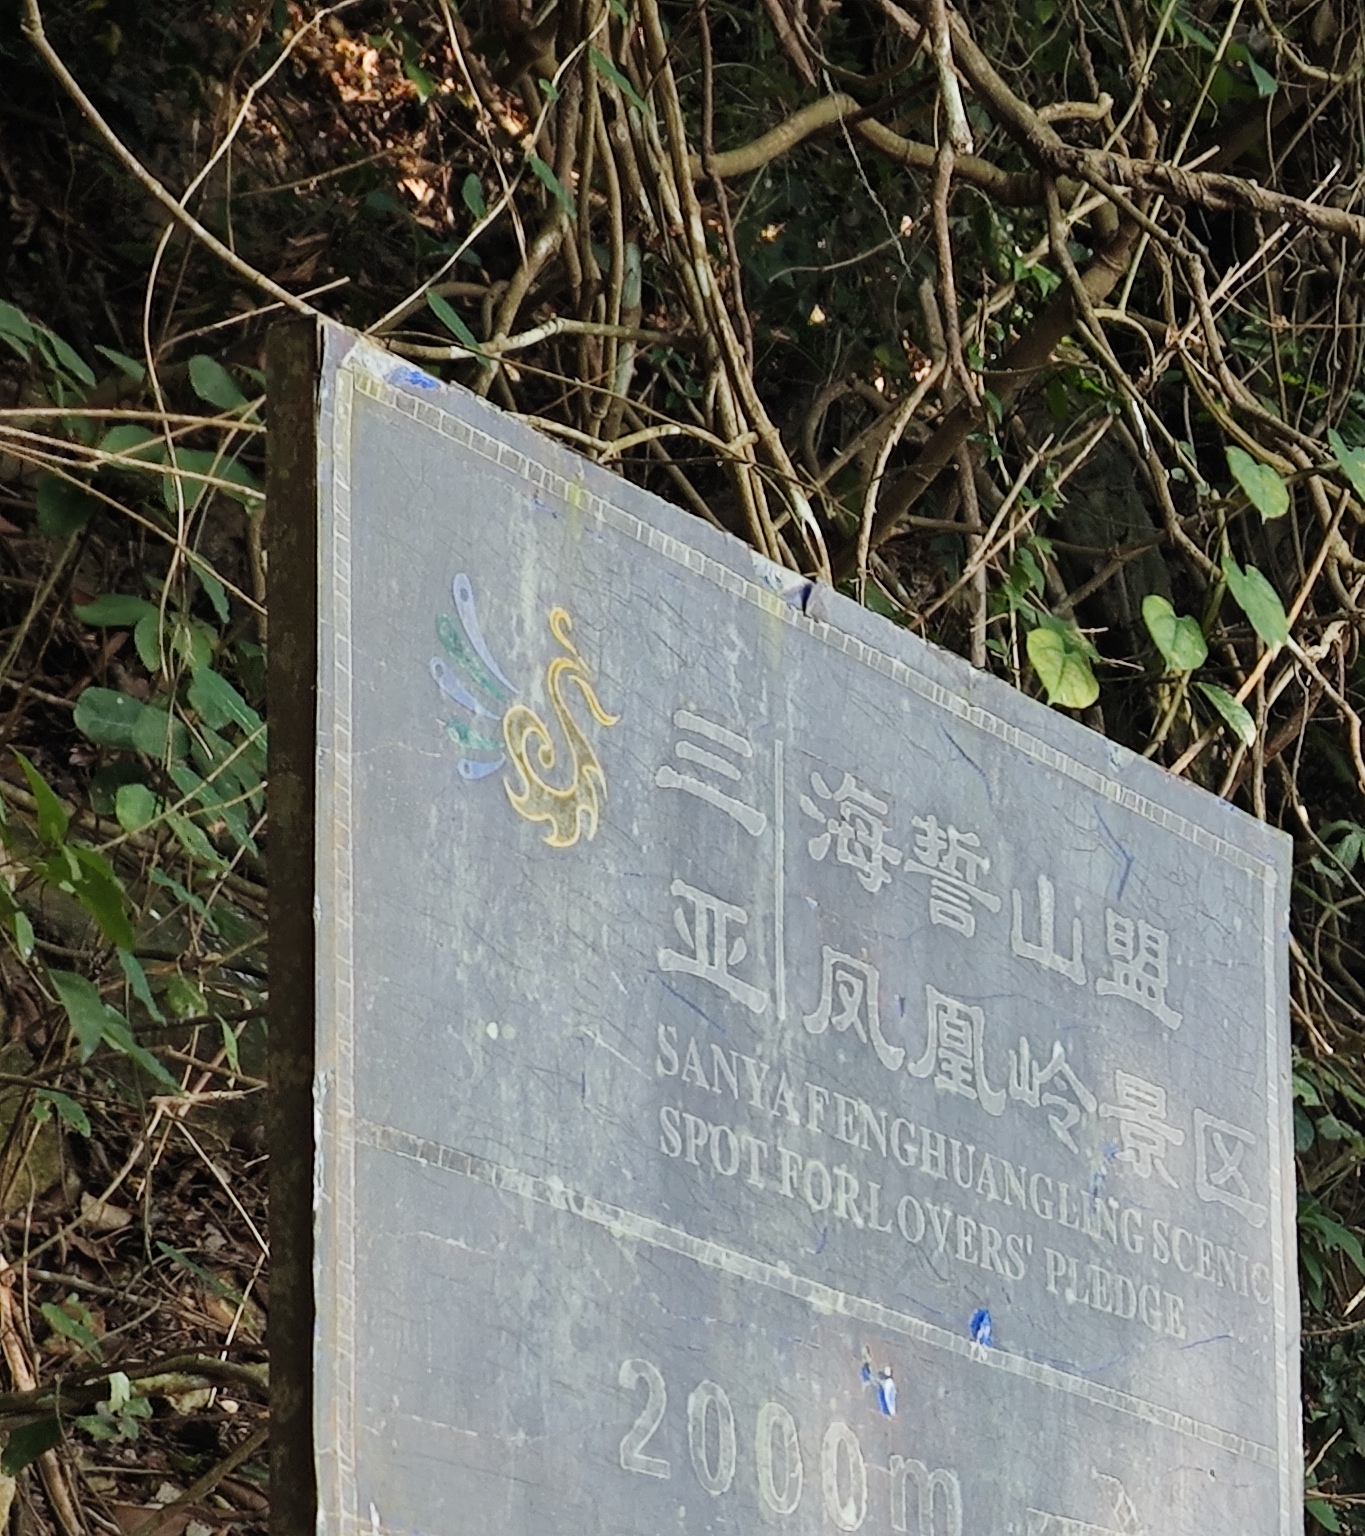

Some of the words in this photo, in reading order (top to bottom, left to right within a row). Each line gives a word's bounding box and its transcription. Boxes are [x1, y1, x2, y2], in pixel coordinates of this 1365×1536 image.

[655, 708, 768, 1015] 三亚
[800, 771, 1183, 1031] 海誓山盟
[803, 944, 1268, 1228] 凤凰岭景区
[659, 1106, 769, 1189] SPOT
[777, 1146, 864, 1229] FOR
[1043, 1246, 1188, 1340] PLEDGE
[1153, 1218, 1271, 1305] SCENIC
